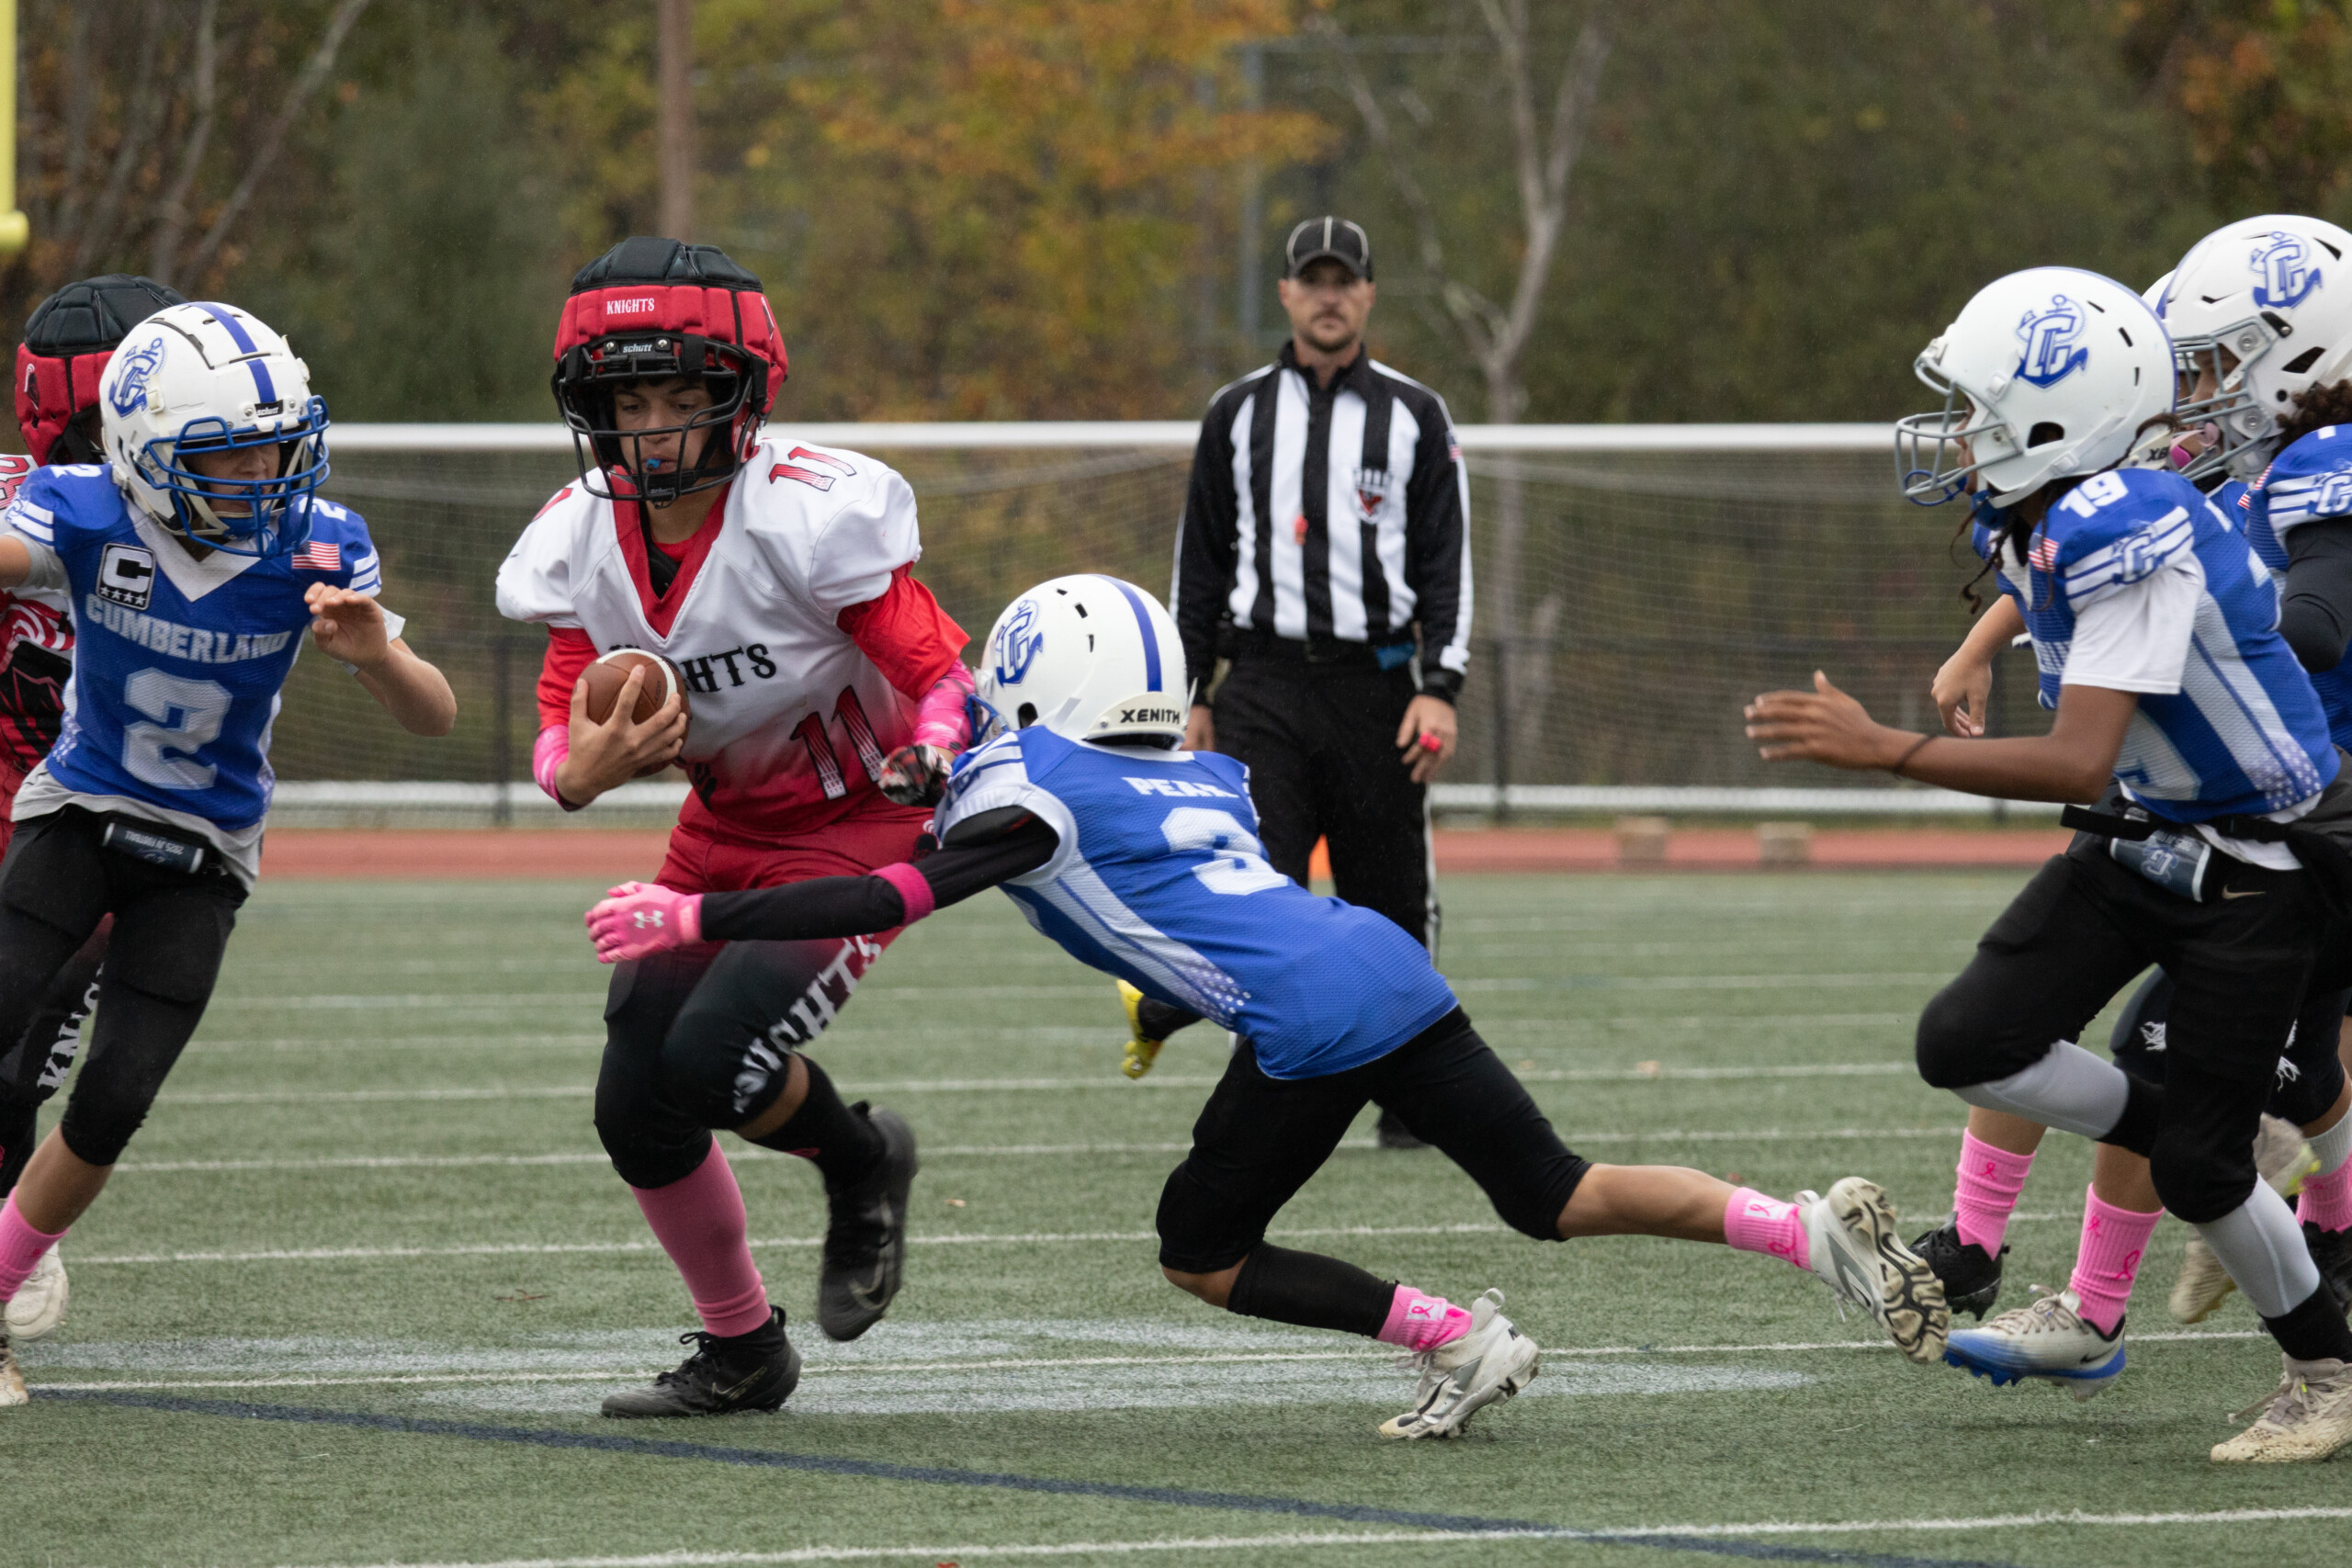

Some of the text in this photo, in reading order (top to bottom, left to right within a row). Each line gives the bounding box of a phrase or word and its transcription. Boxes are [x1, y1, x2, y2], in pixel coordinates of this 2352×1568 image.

[606, 298, 655, 315] KNIGHTS
[623, 344, 653, 354] schutt
[769, 446, 857, 492] 11
[2058, 469, 2130, 519] 19
[102, 547, 153, 593] C
[85, 593, 292, 663] CUMBERLAND
[120, 667, 233, 790] 2
[1120, 708, 1181, 725] XENITH
[789, 684, 885, 800] 11
[1159, 807, 1289, 896] 3
